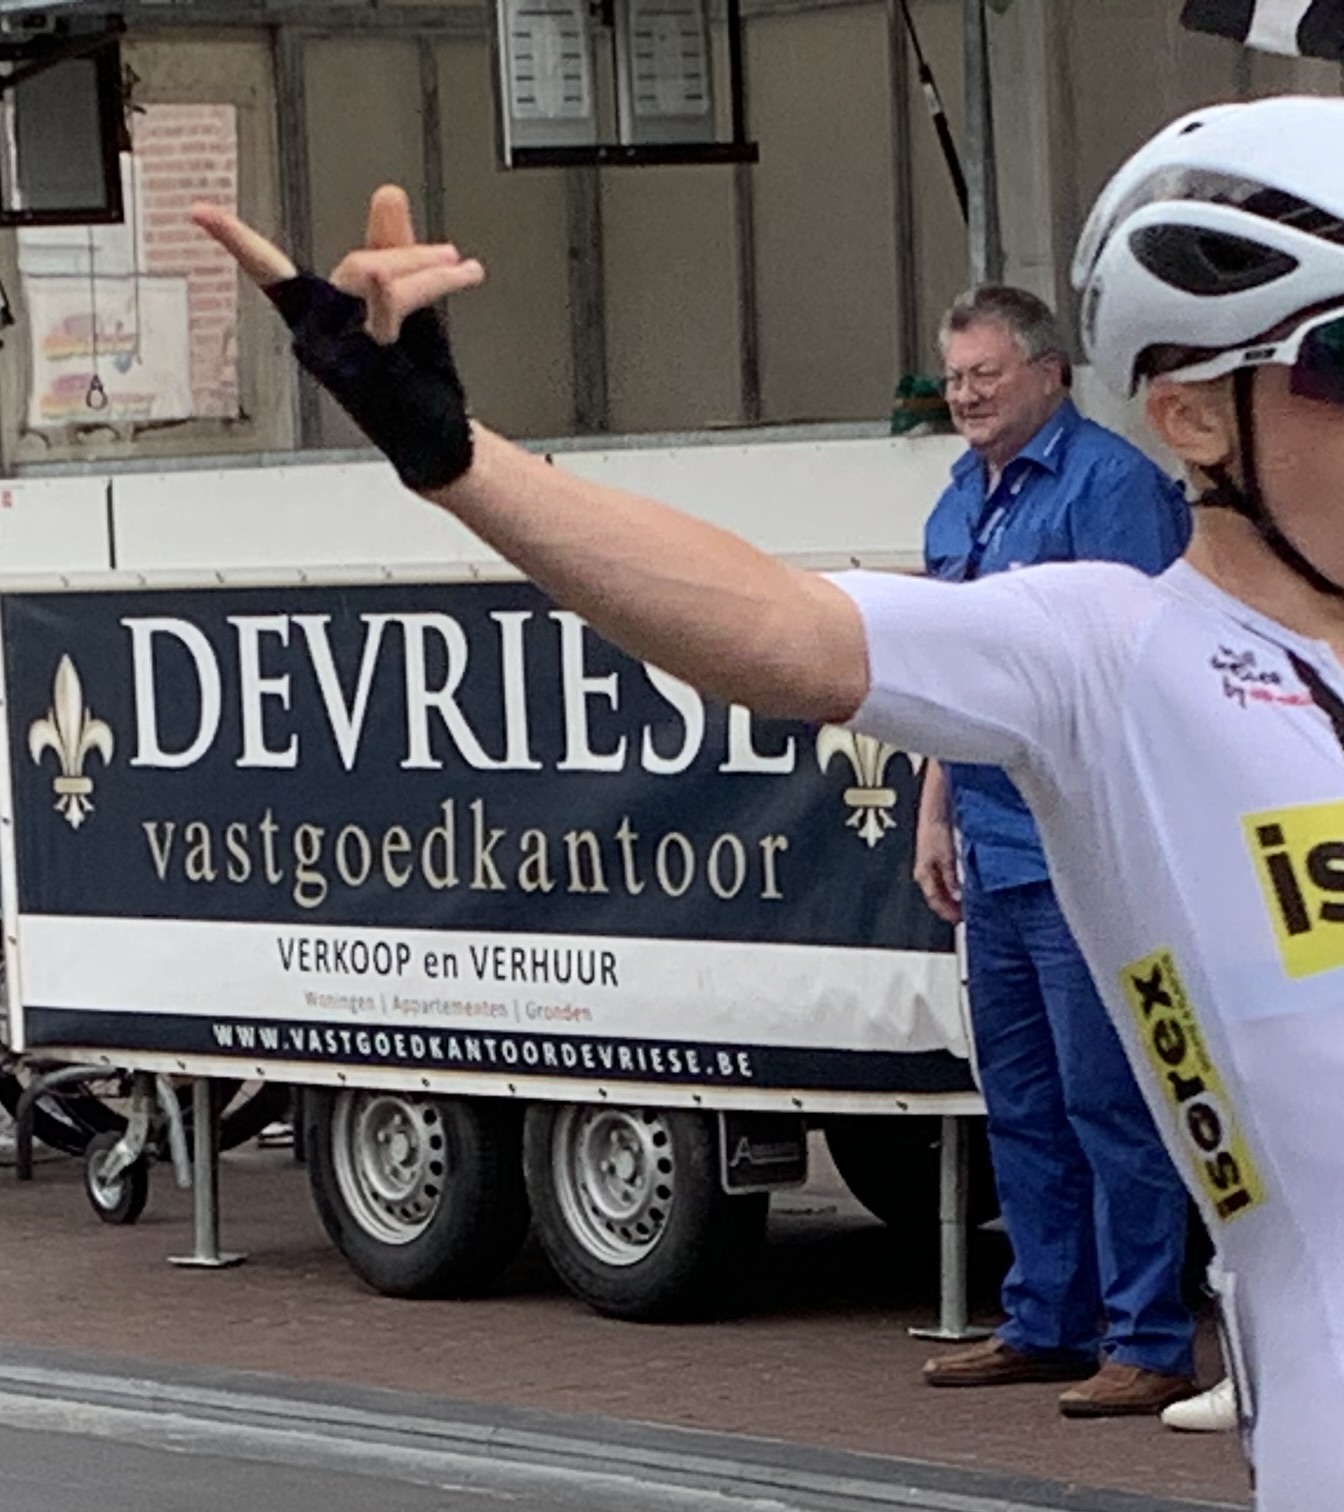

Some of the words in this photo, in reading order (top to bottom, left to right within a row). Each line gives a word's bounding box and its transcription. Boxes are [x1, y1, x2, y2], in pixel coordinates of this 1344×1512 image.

[141, 797, 790, 909] vastgoedkantoor
[276, 936, 412, 978] VERKOOP
[423, 947, 459, 979] en
[468, 944, 619, 988] VERHUUR
[525, 1002, 593, 1023] Gronden
[212, 1022, 754, 1079] WWW.VASTGOEDKANTOORDEVRIESE.BE
